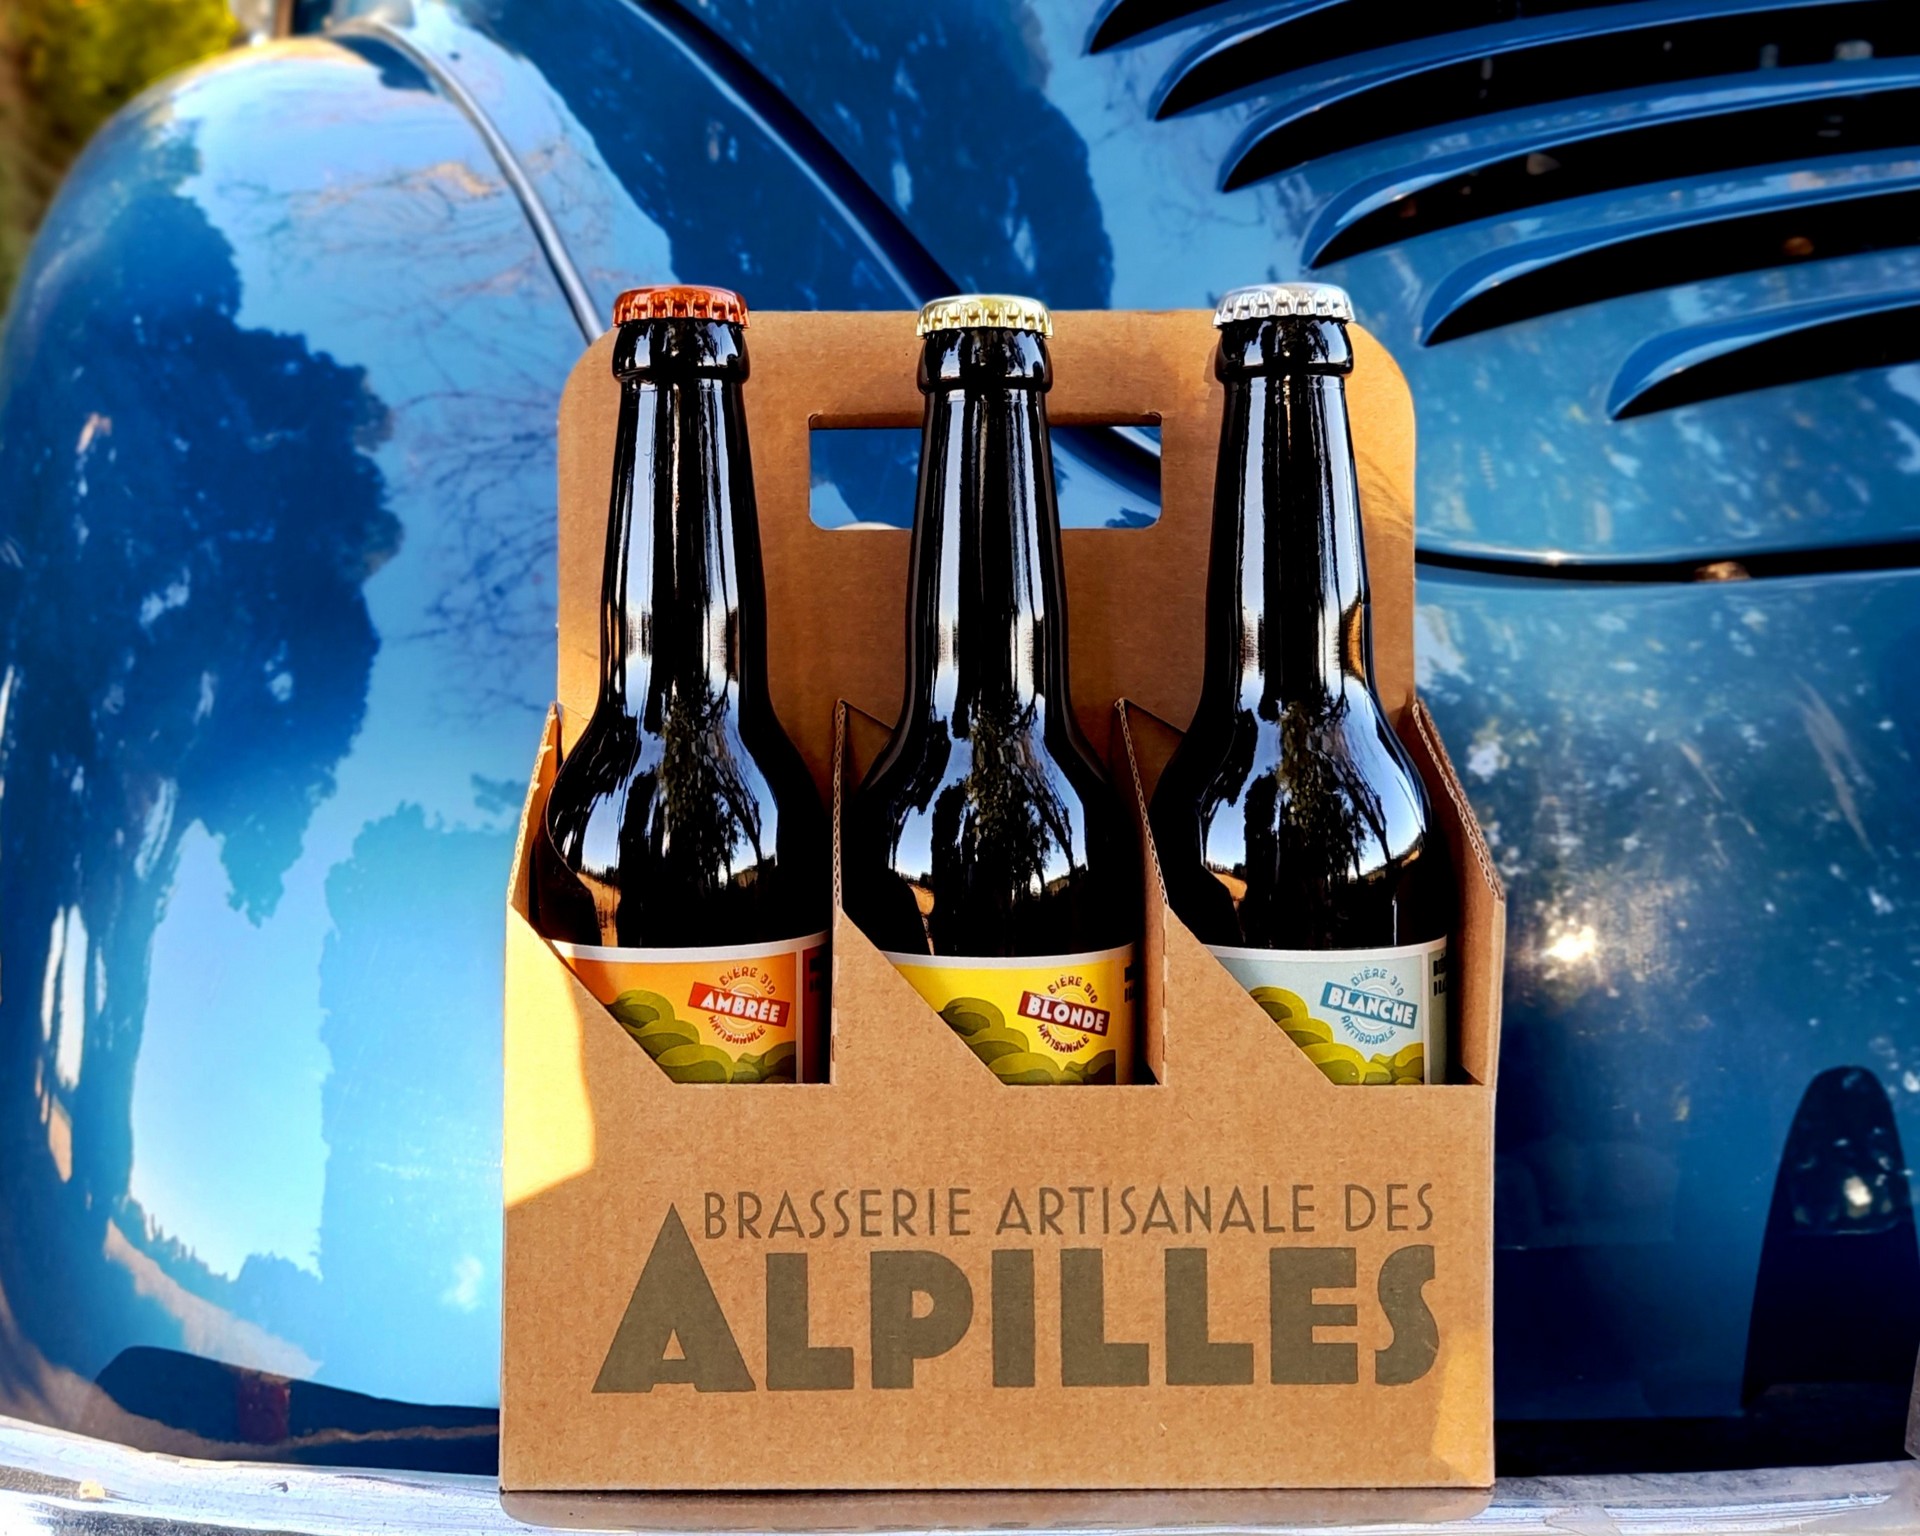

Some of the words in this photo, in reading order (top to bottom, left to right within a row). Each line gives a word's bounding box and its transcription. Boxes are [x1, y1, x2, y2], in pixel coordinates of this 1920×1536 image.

[700, 989, 781, 1024] AMBRÉE
[1026, 993, 1105, 1033] BLONDE
[1327, 985, 1415, 1026] BLANCHE
[708, 1014, 767, 1045] ARTISANALE
[1037, 1022, 1090, 1053] ARTISANALE
[1341, 1014, 1396, 1045] ARTISANALE
[704, 1188, 972, 1240] BRASSERIE
[996, 1184, 1316, 1236] ARTISANALE
[1344, 1183, 1433, 1233] DES
[591, 1202, 1439, 1394] ALPILLES
